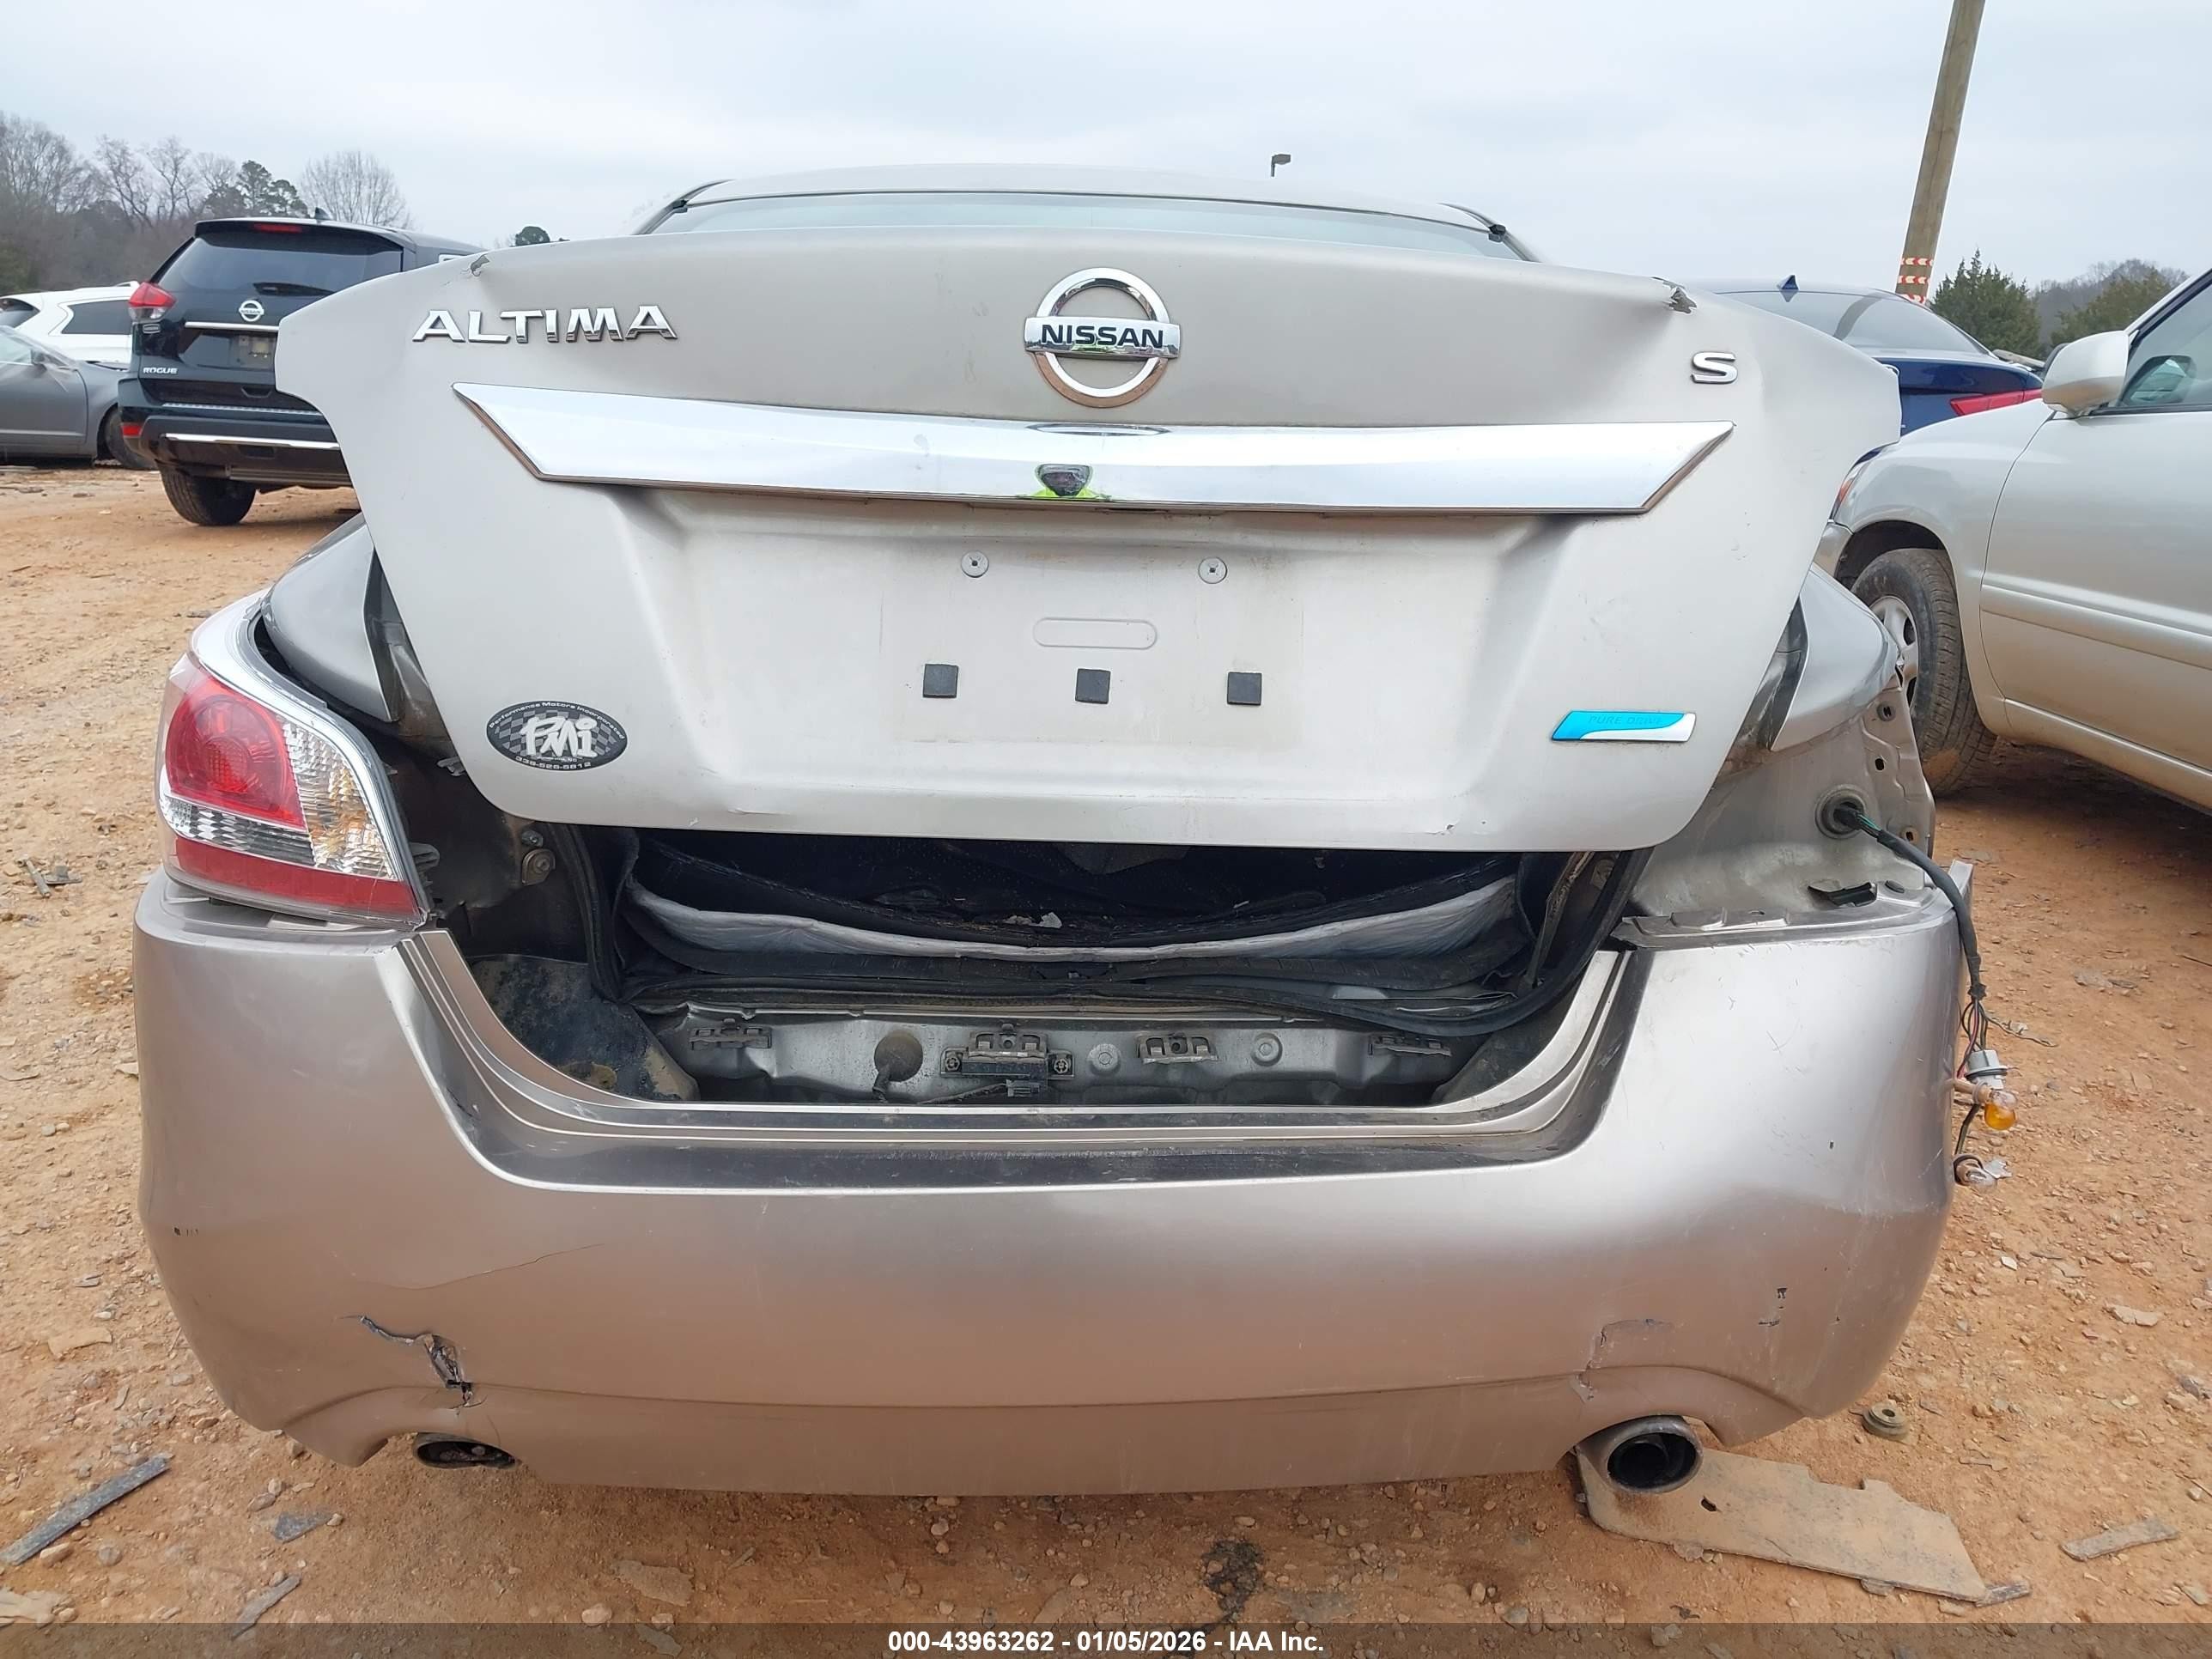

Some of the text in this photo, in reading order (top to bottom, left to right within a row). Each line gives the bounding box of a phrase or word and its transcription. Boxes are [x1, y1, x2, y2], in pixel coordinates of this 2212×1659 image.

[412, 305, 678, 343] ALTIMA
[1041, 324, 1164, 349] NISSAN
[1690, 350, 1738, 385] S
[1589, 714, 1622, 725] PURE
